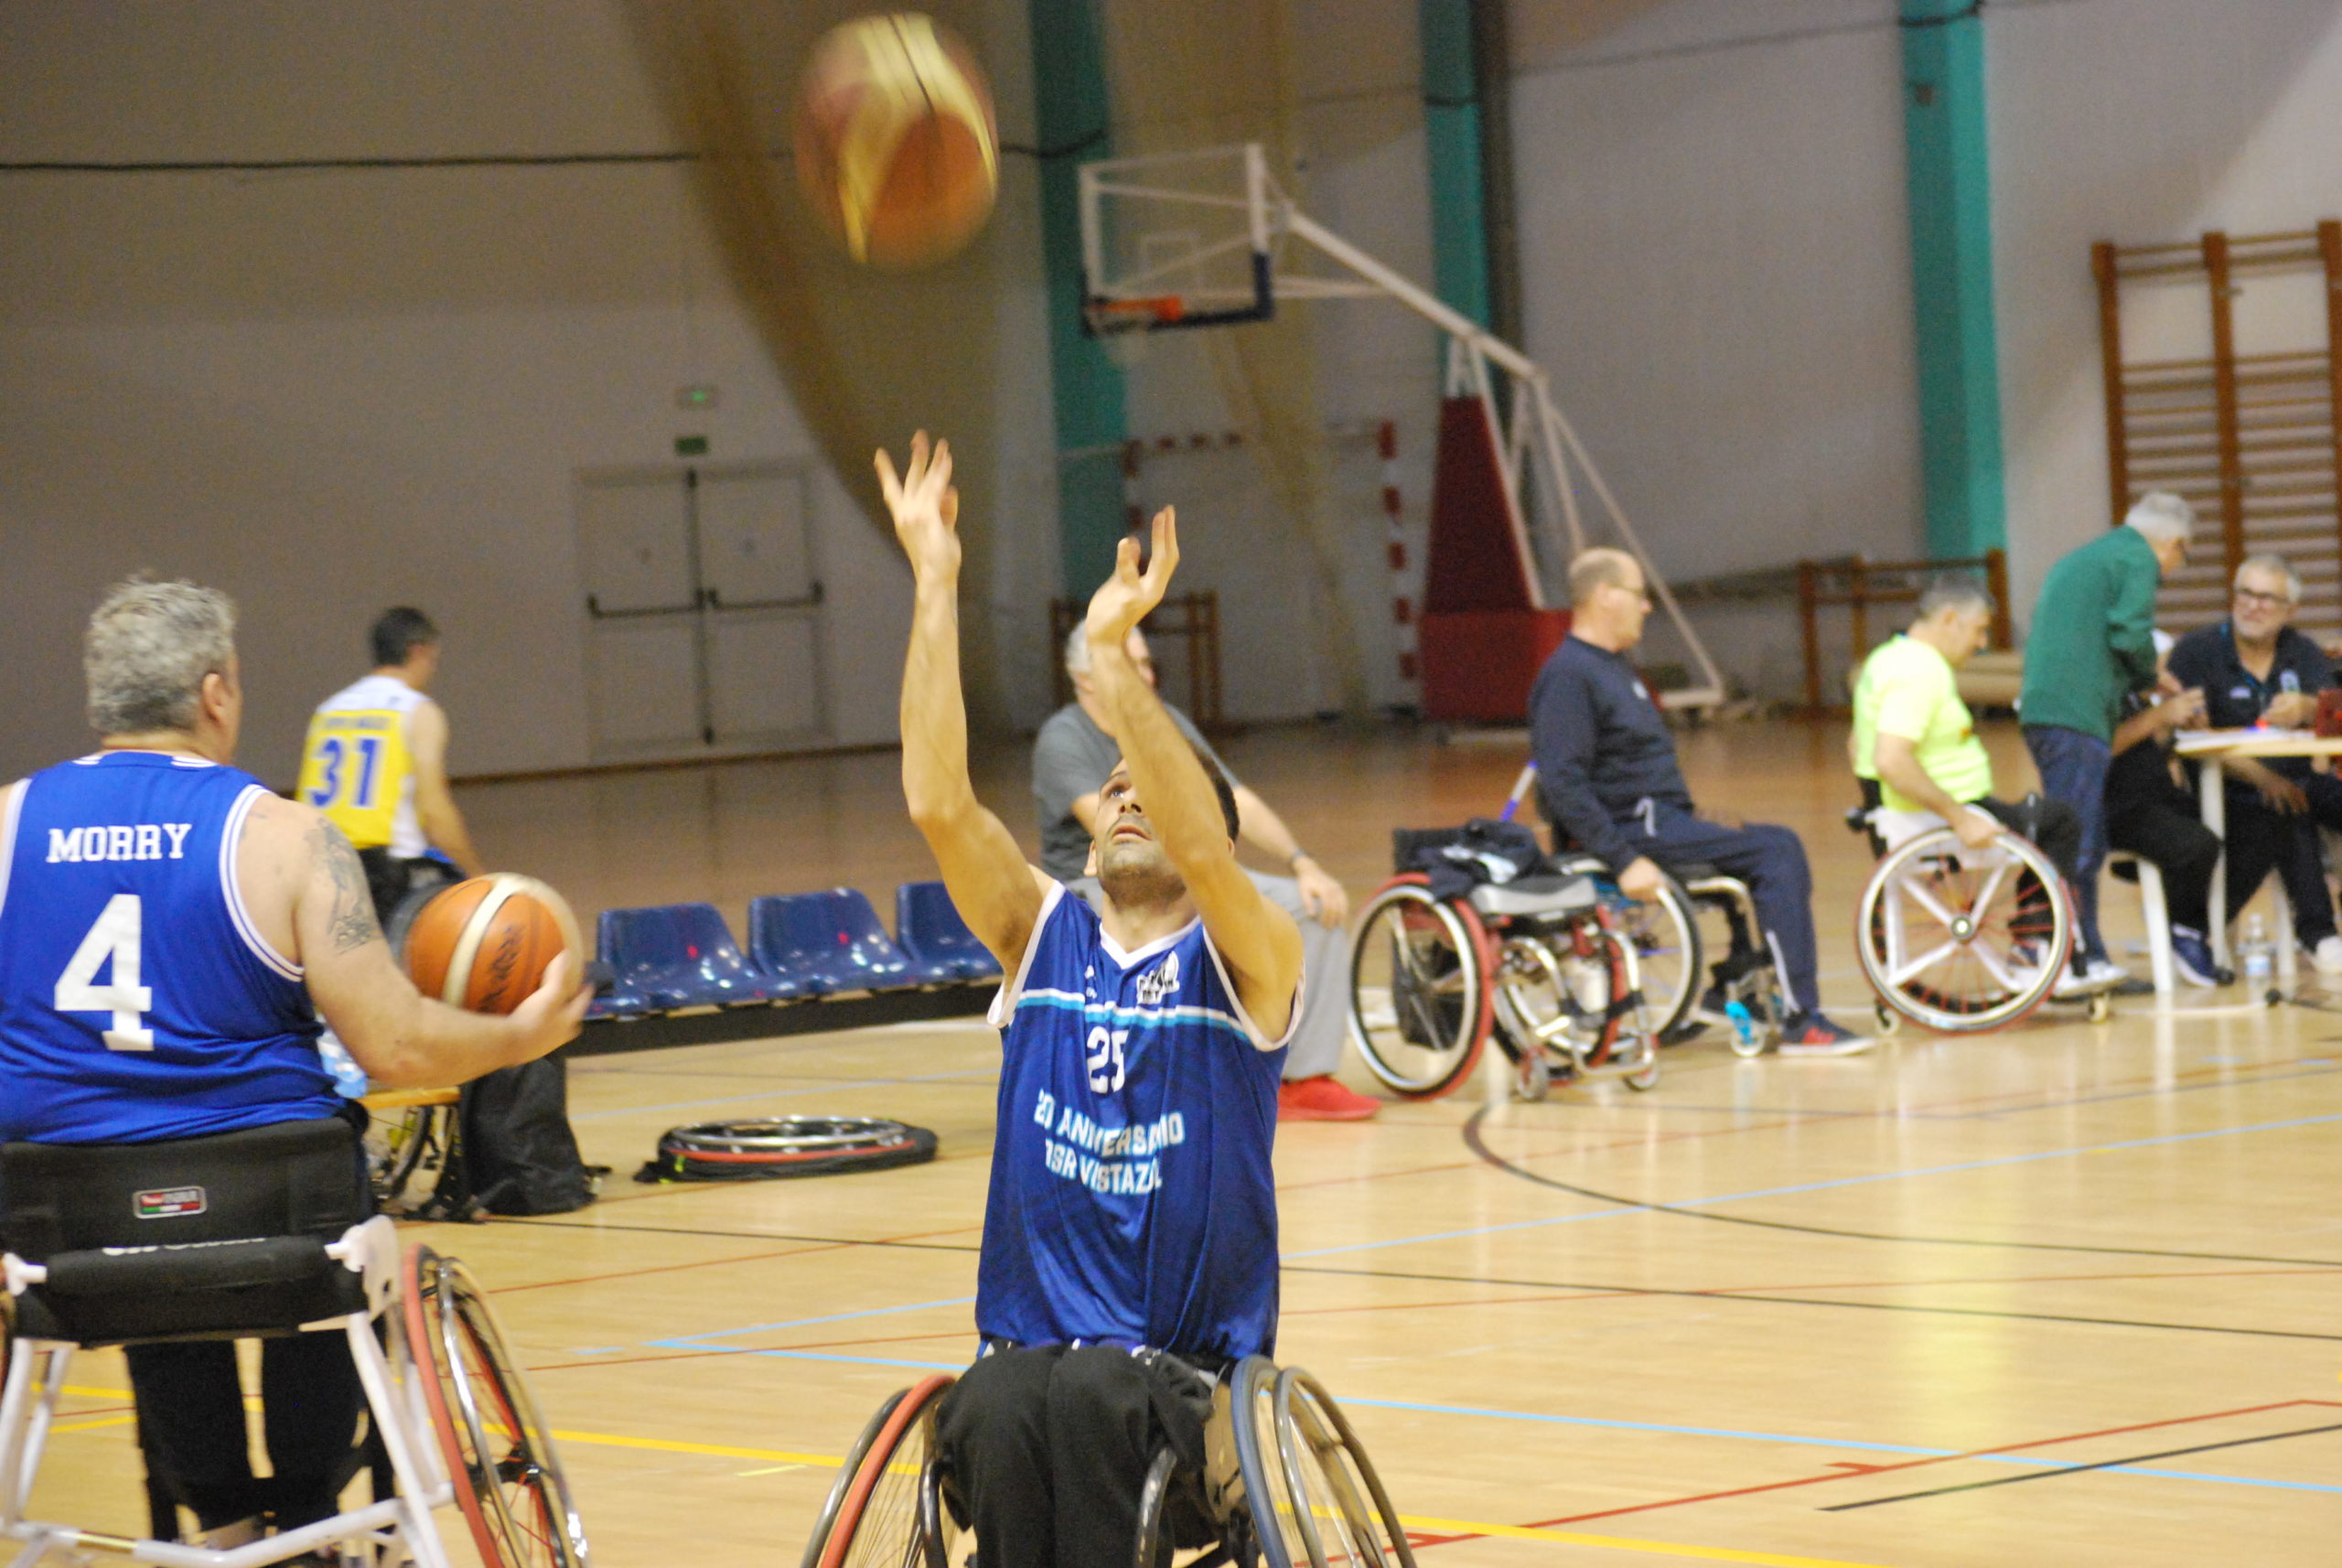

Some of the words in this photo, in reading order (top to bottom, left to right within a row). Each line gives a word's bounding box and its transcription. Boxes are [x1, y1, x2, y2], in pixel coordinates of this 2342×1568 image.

[308, 736, 383, 808] 31
[46, 823, 192, 863] MORRY
[54, 894, 154, 1050] 4
[1087, 1026, 1129, 1094] 25
